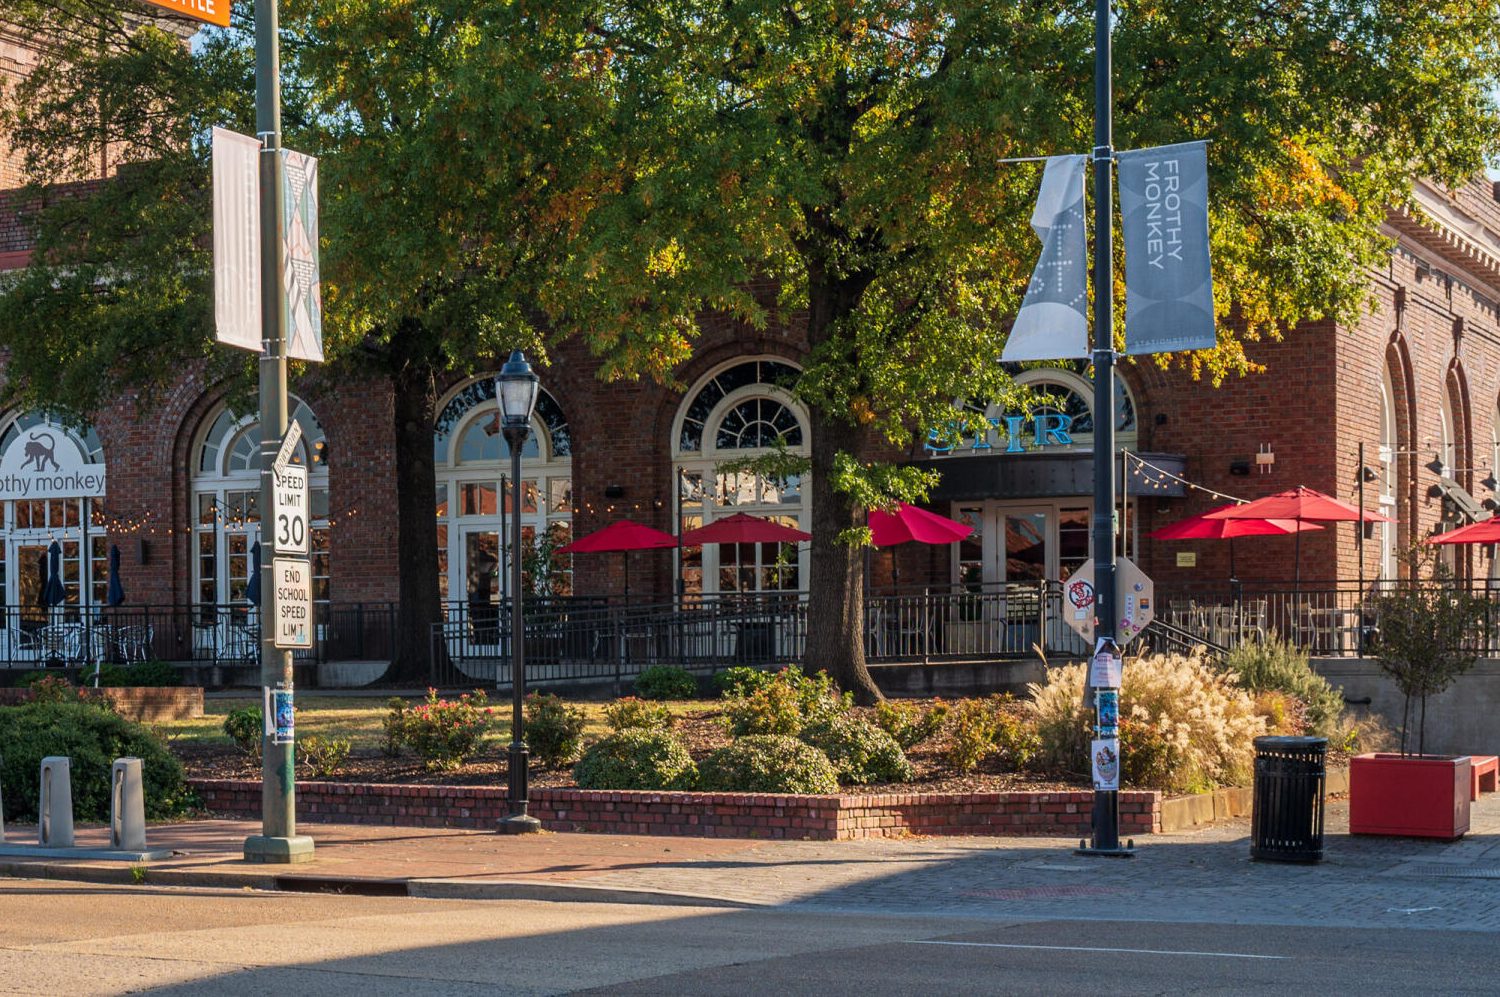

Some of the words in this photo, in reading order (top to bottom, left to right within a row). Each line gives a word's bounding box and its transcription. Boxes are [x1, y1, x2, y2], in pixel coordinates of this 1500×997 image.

[1144, 162, 1164, 269] MONKEY
[1164, 159, 1183, 261] FROTHY
[276, 427, 299, 473] DOWNTOWN
[36, 471, 105, 493] monkey
[276, 476, 303, 489] SPEED
[279, 493, 301, 507] LIMIT
[278, 514, 304, 545] 30
[284, 570, 301, 583] END
[278, 587, 308, 601] SCHOOL
[281, 605, 306, 619] SPEED
